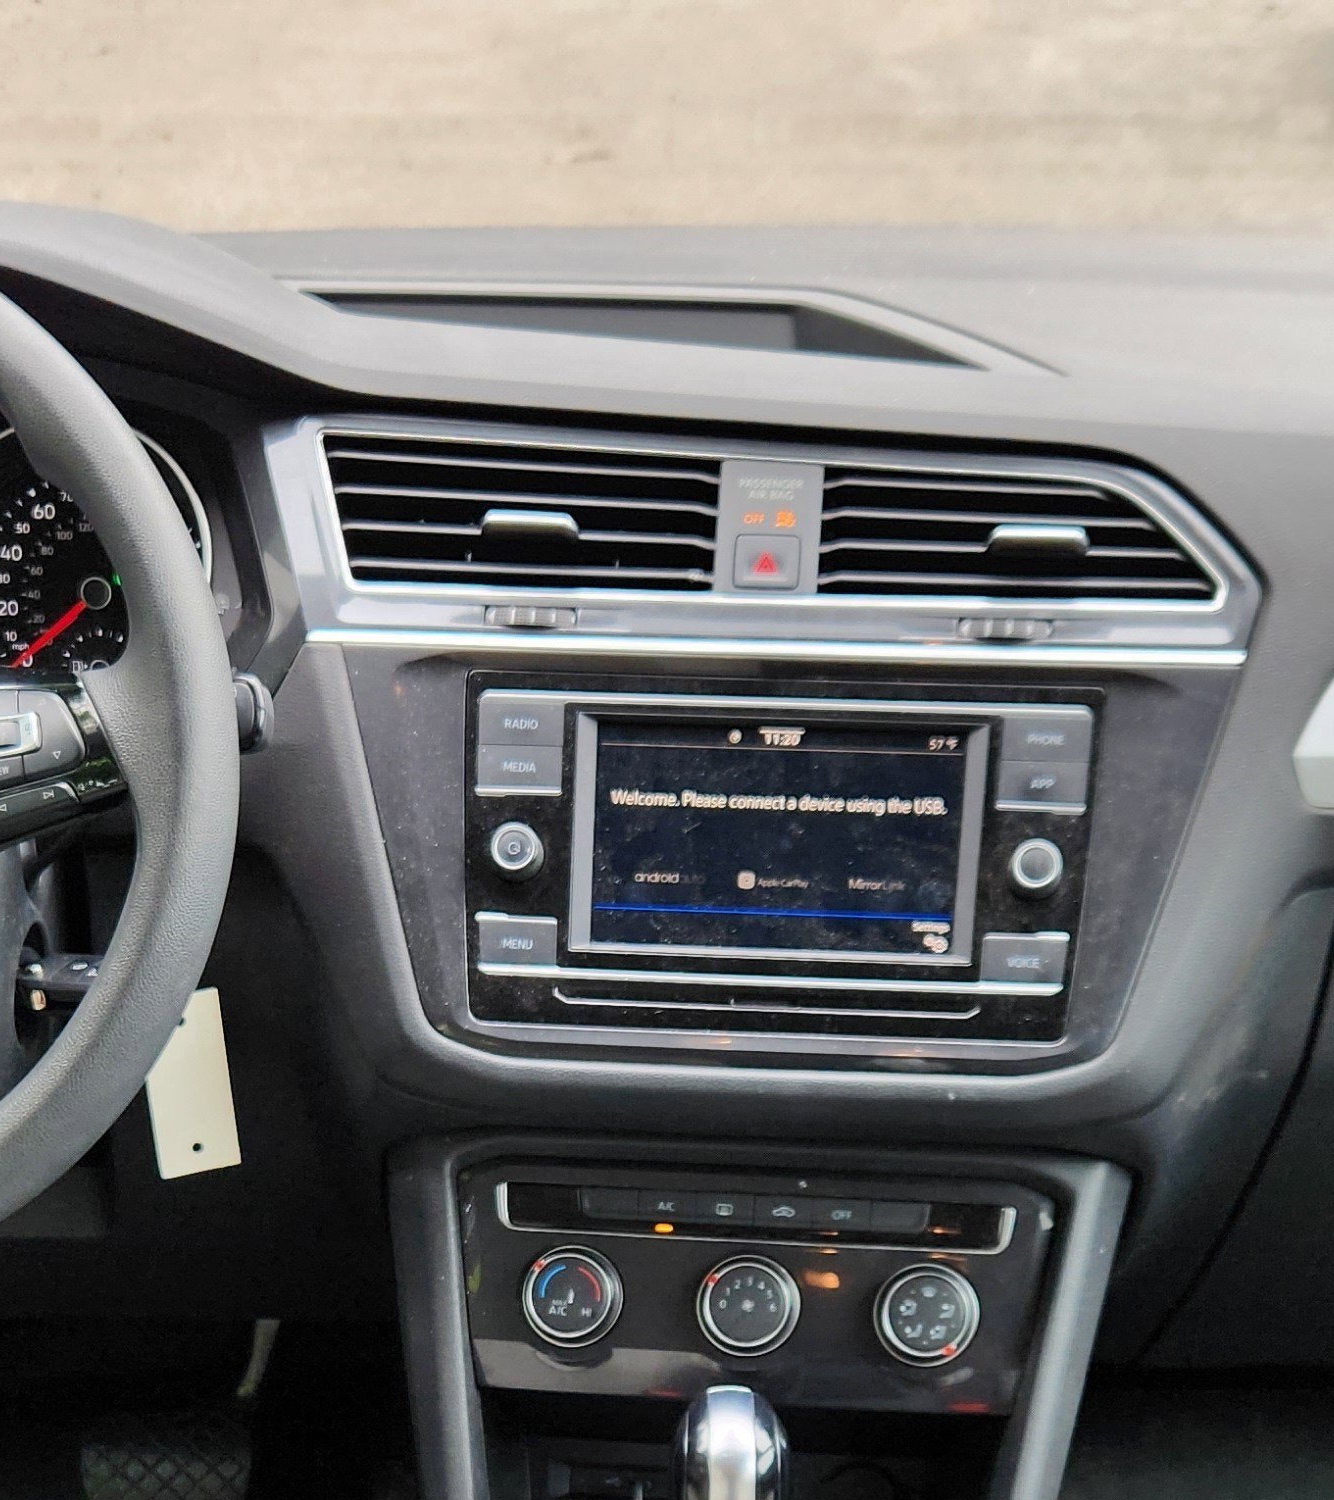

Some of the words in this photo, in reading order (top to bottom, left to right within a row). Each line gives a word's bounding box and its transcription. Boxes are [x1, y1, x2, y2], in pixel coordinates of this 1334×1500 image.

[738, 478, 804, 489] PASSENGER
[770, 490, 795, 501] BAG
[31, 504, 56, 520] 60
[743, 511, 765, 524] OFF
[15, 523, 31, 534] 50
[56, 531, 73, 541] 100
[0, 545, 23, 561] 40
[41, 546, 55, 556] 80
[30, 566, 44, 576] 60
[5, 631, 17, 643] 10
[504, 718, 539, 730] RADIO
[1027, 733, 1065, 746] PHONE
[503, 761, 537, 773] MEDIA
[1029, 779, 1056, 789] APP
[610, 788, 680, 807] Welcome.
[681, 789, 727, 808] Please
[729, 793, 786, 811] connect
[786, 797, 797, 811] a
[798, 794, 846, 813] device
[846, 796, 887, 816] using
[887, 796, 913, 815] the
[913, 796, 948, 816] USB.
[634, 872, 680, 884] android
[502, 938, 534, 950] MENU
[1007, 957, 1040, 969] VOICE
[658, 1201, 675, 1212] A/C
[830, 1209, 853, 1220] OFF
[548, 1305, 567, 1317] A/C
[581, 1307, 593, 1317] HI
